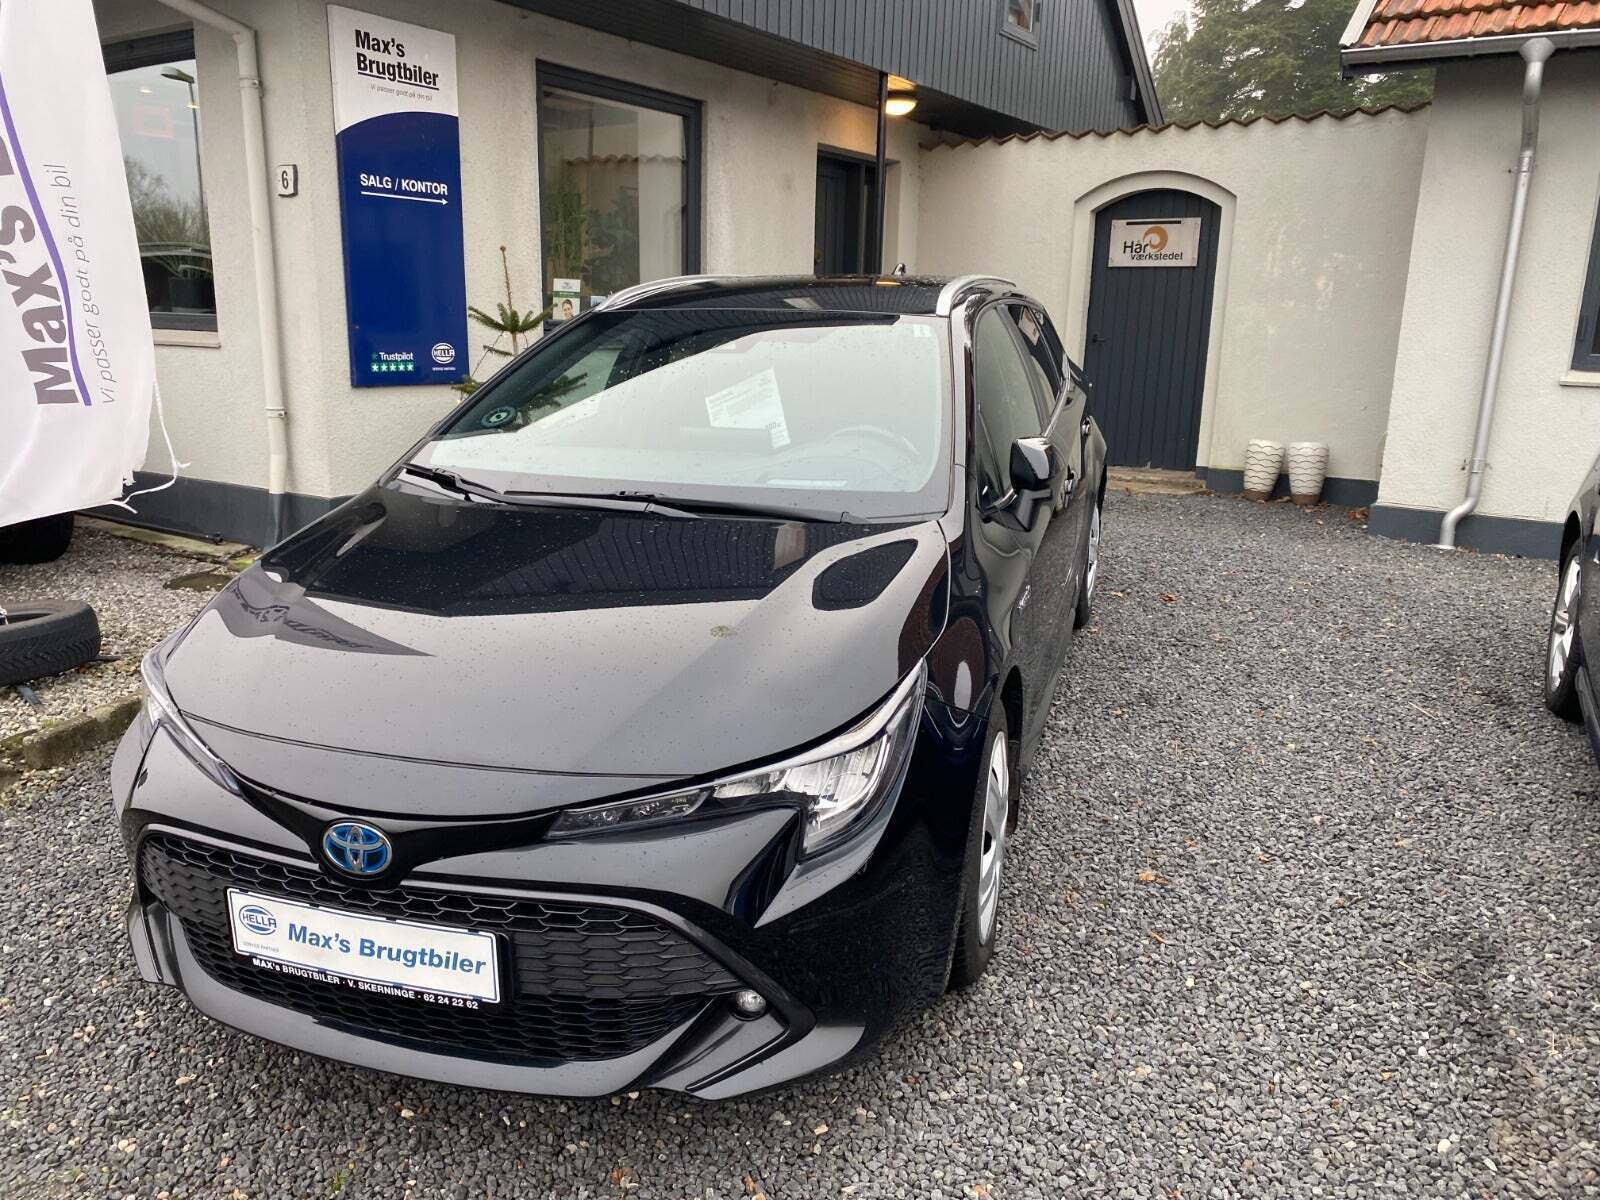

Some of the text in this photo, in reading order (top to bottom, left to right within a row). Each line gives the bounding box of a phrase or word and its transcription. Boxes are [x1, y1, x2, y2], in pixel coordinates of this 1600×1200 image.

[355, 29, 406, 58] Max's
[356, 52, 439, 86] Brugtbiler
[43, 164, 72, 188] bil
[281, 170, 289, 190] 6
[360, 174, 392, 189] SALG
[401, 179, 448, 195] KONTOR
[60, 196, 81, 228] din
[68, 235, 90, 263] på
[76, 267, 99, 316] godt
[85, 319, 117, 384] passer
[379, 352, 414, 362] Trustpilot
[434, 349, 455, 357] HELLA
[242, 912, 277, 929] HELLA
[288, 923, 487, 974] Max's Brugtbiler
[252, 958, 280, 971] MAX's
[282, 965, 340, 985] BRUGTBILER
[347, 979, 356, 988] V.
[358, 981, 416, 999] SKERNINGE
[423, 993, 436, 1003] 62
[437, 995, 450, 1005] 24
[452, 998, 464, 1007] 22
[466, 1000, 479, 1010] 62
